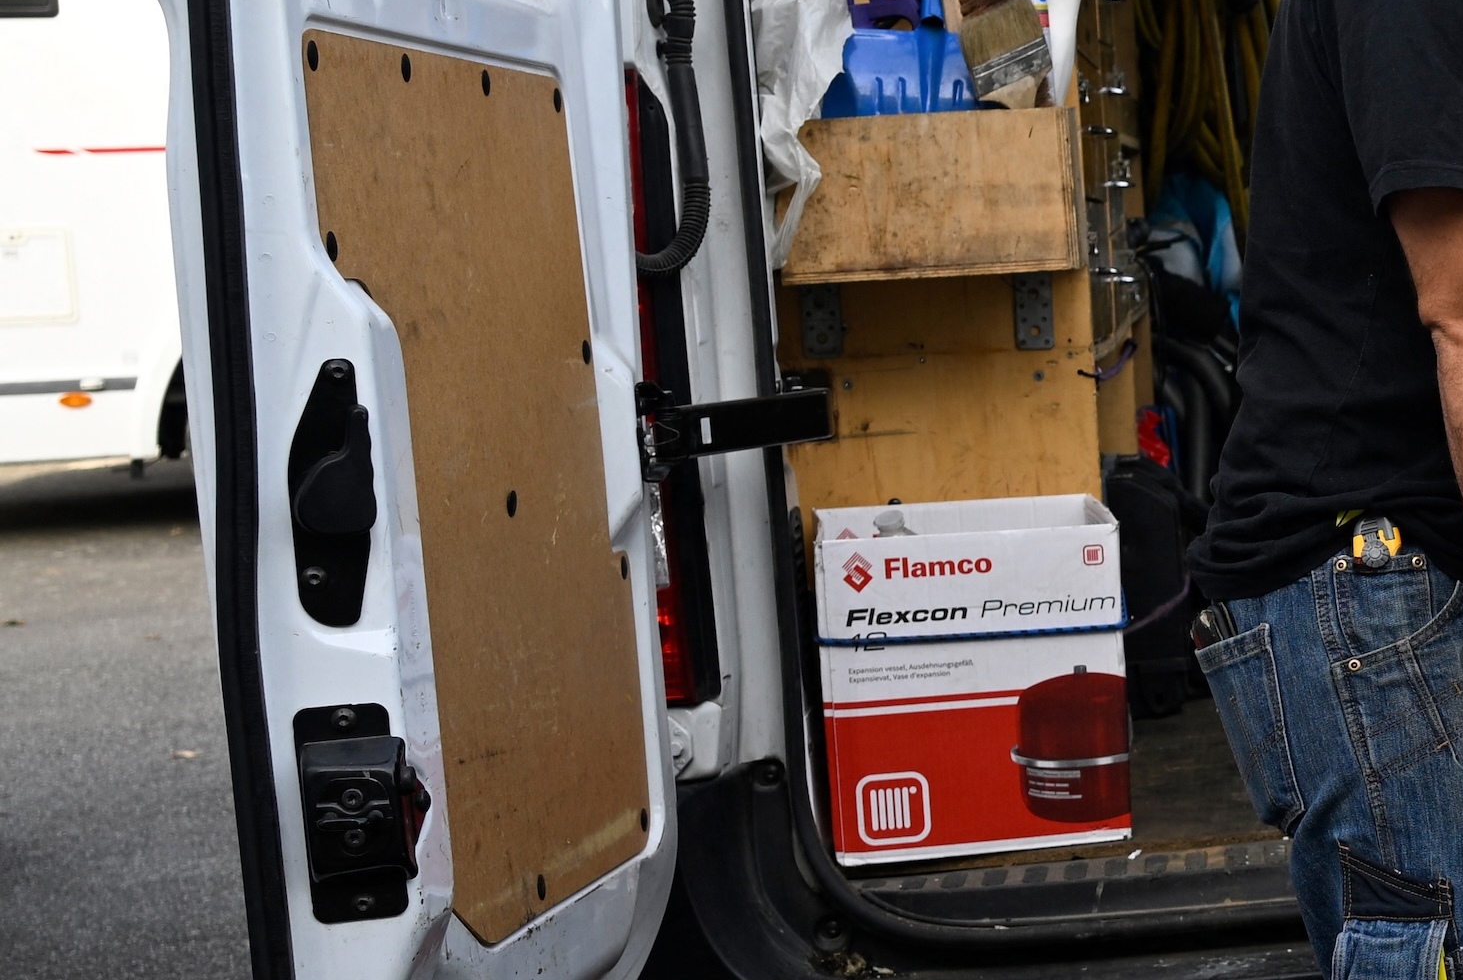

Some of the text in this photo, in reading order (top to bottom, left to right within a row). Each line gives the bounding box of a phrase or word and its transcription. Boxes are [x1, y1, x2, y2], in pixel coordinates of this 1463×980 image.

[884, 557, 992, 579] Flamco
[846, 594, 1115, 627] Flexcon Premium
[848, 659, 973, 676] Expansion vessel, Ausdehnungsgefäß
[849, 670, 951, 684] Expansievat, Vase d'expansion
